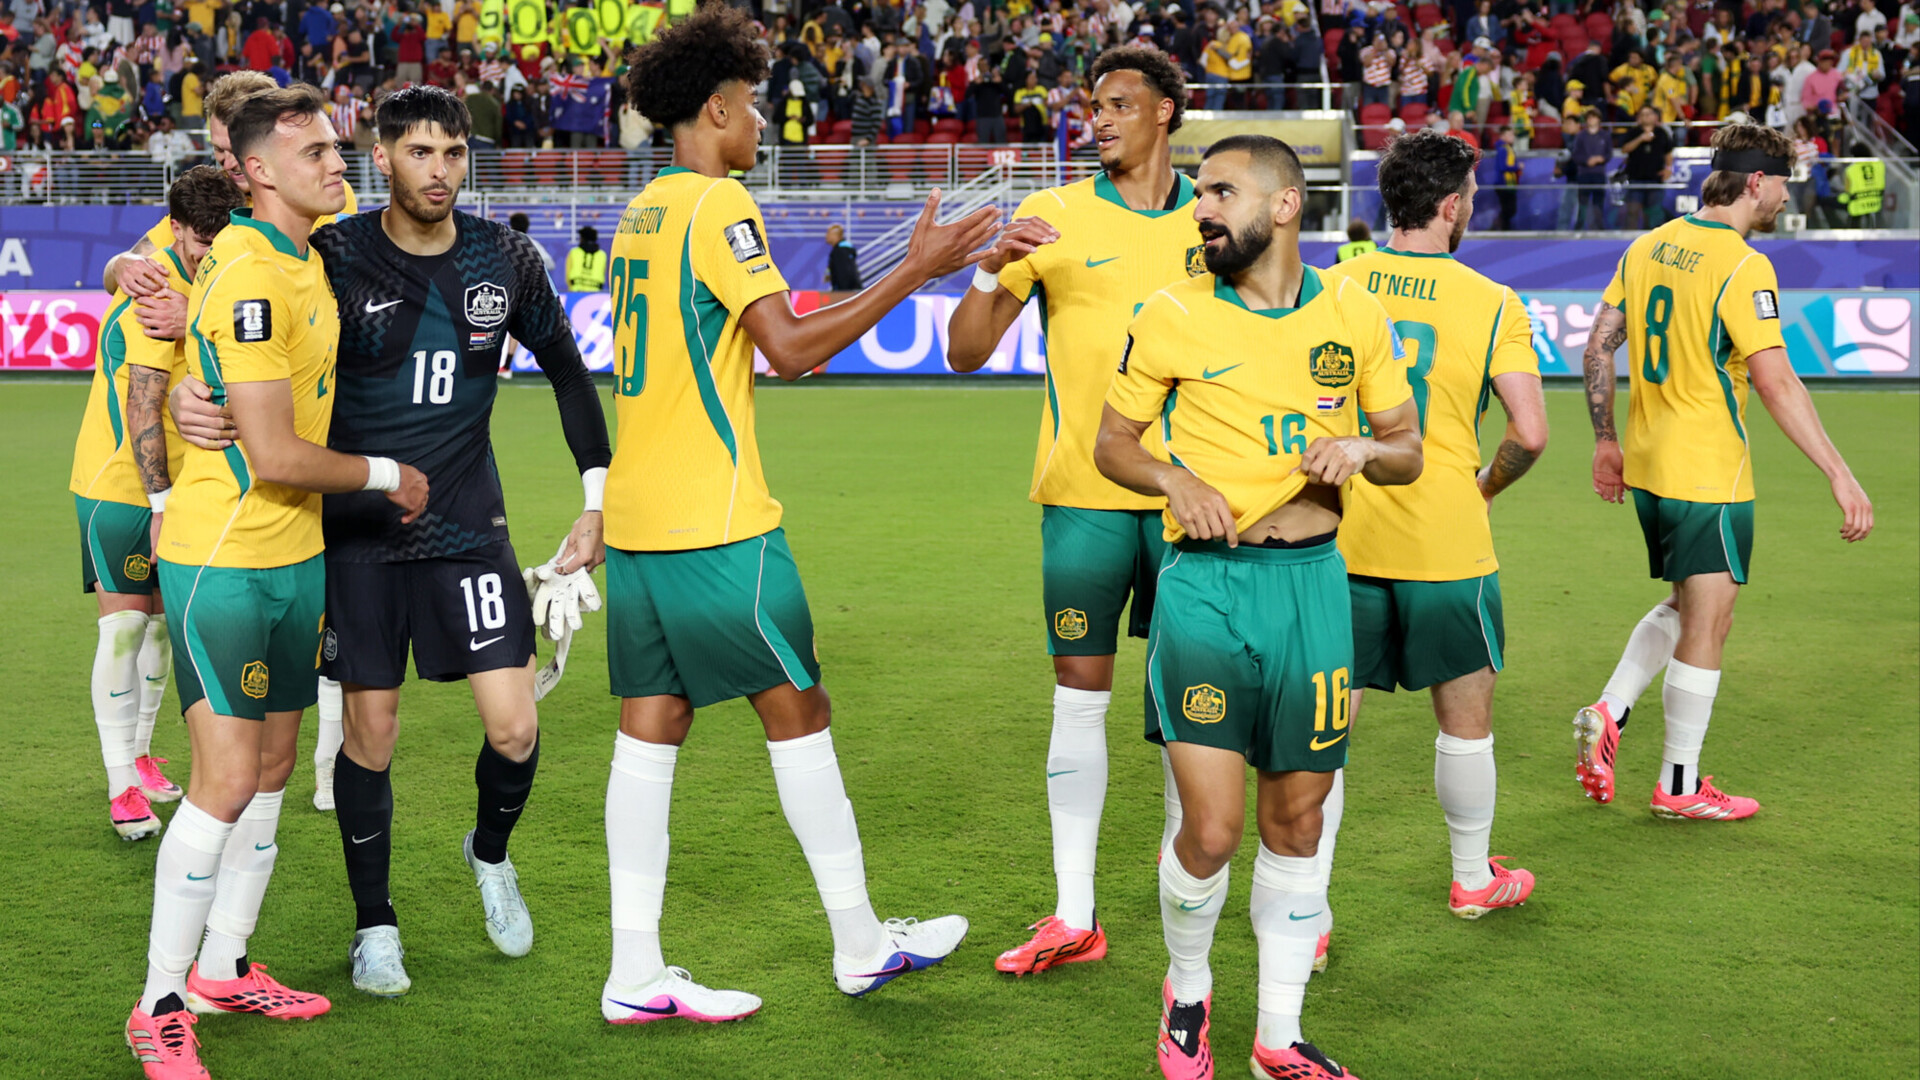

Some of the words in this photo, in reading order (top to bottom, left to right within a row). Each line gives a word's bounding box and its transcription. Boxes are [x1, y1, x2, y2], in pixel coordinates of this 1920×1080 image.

[1367, 270, 1437, 301] O'NEILL
[1649, 240, 1704, 273] METCALFE
[610, 256, 650, 397] 25
[1643, 284, 1674, 385] 8
[412, 350, 457, 405] 18
[1260, 413, 1308, 456] 16
[460, 572, 507, 633] 18
[1311, 666, 1350, 732] 16
